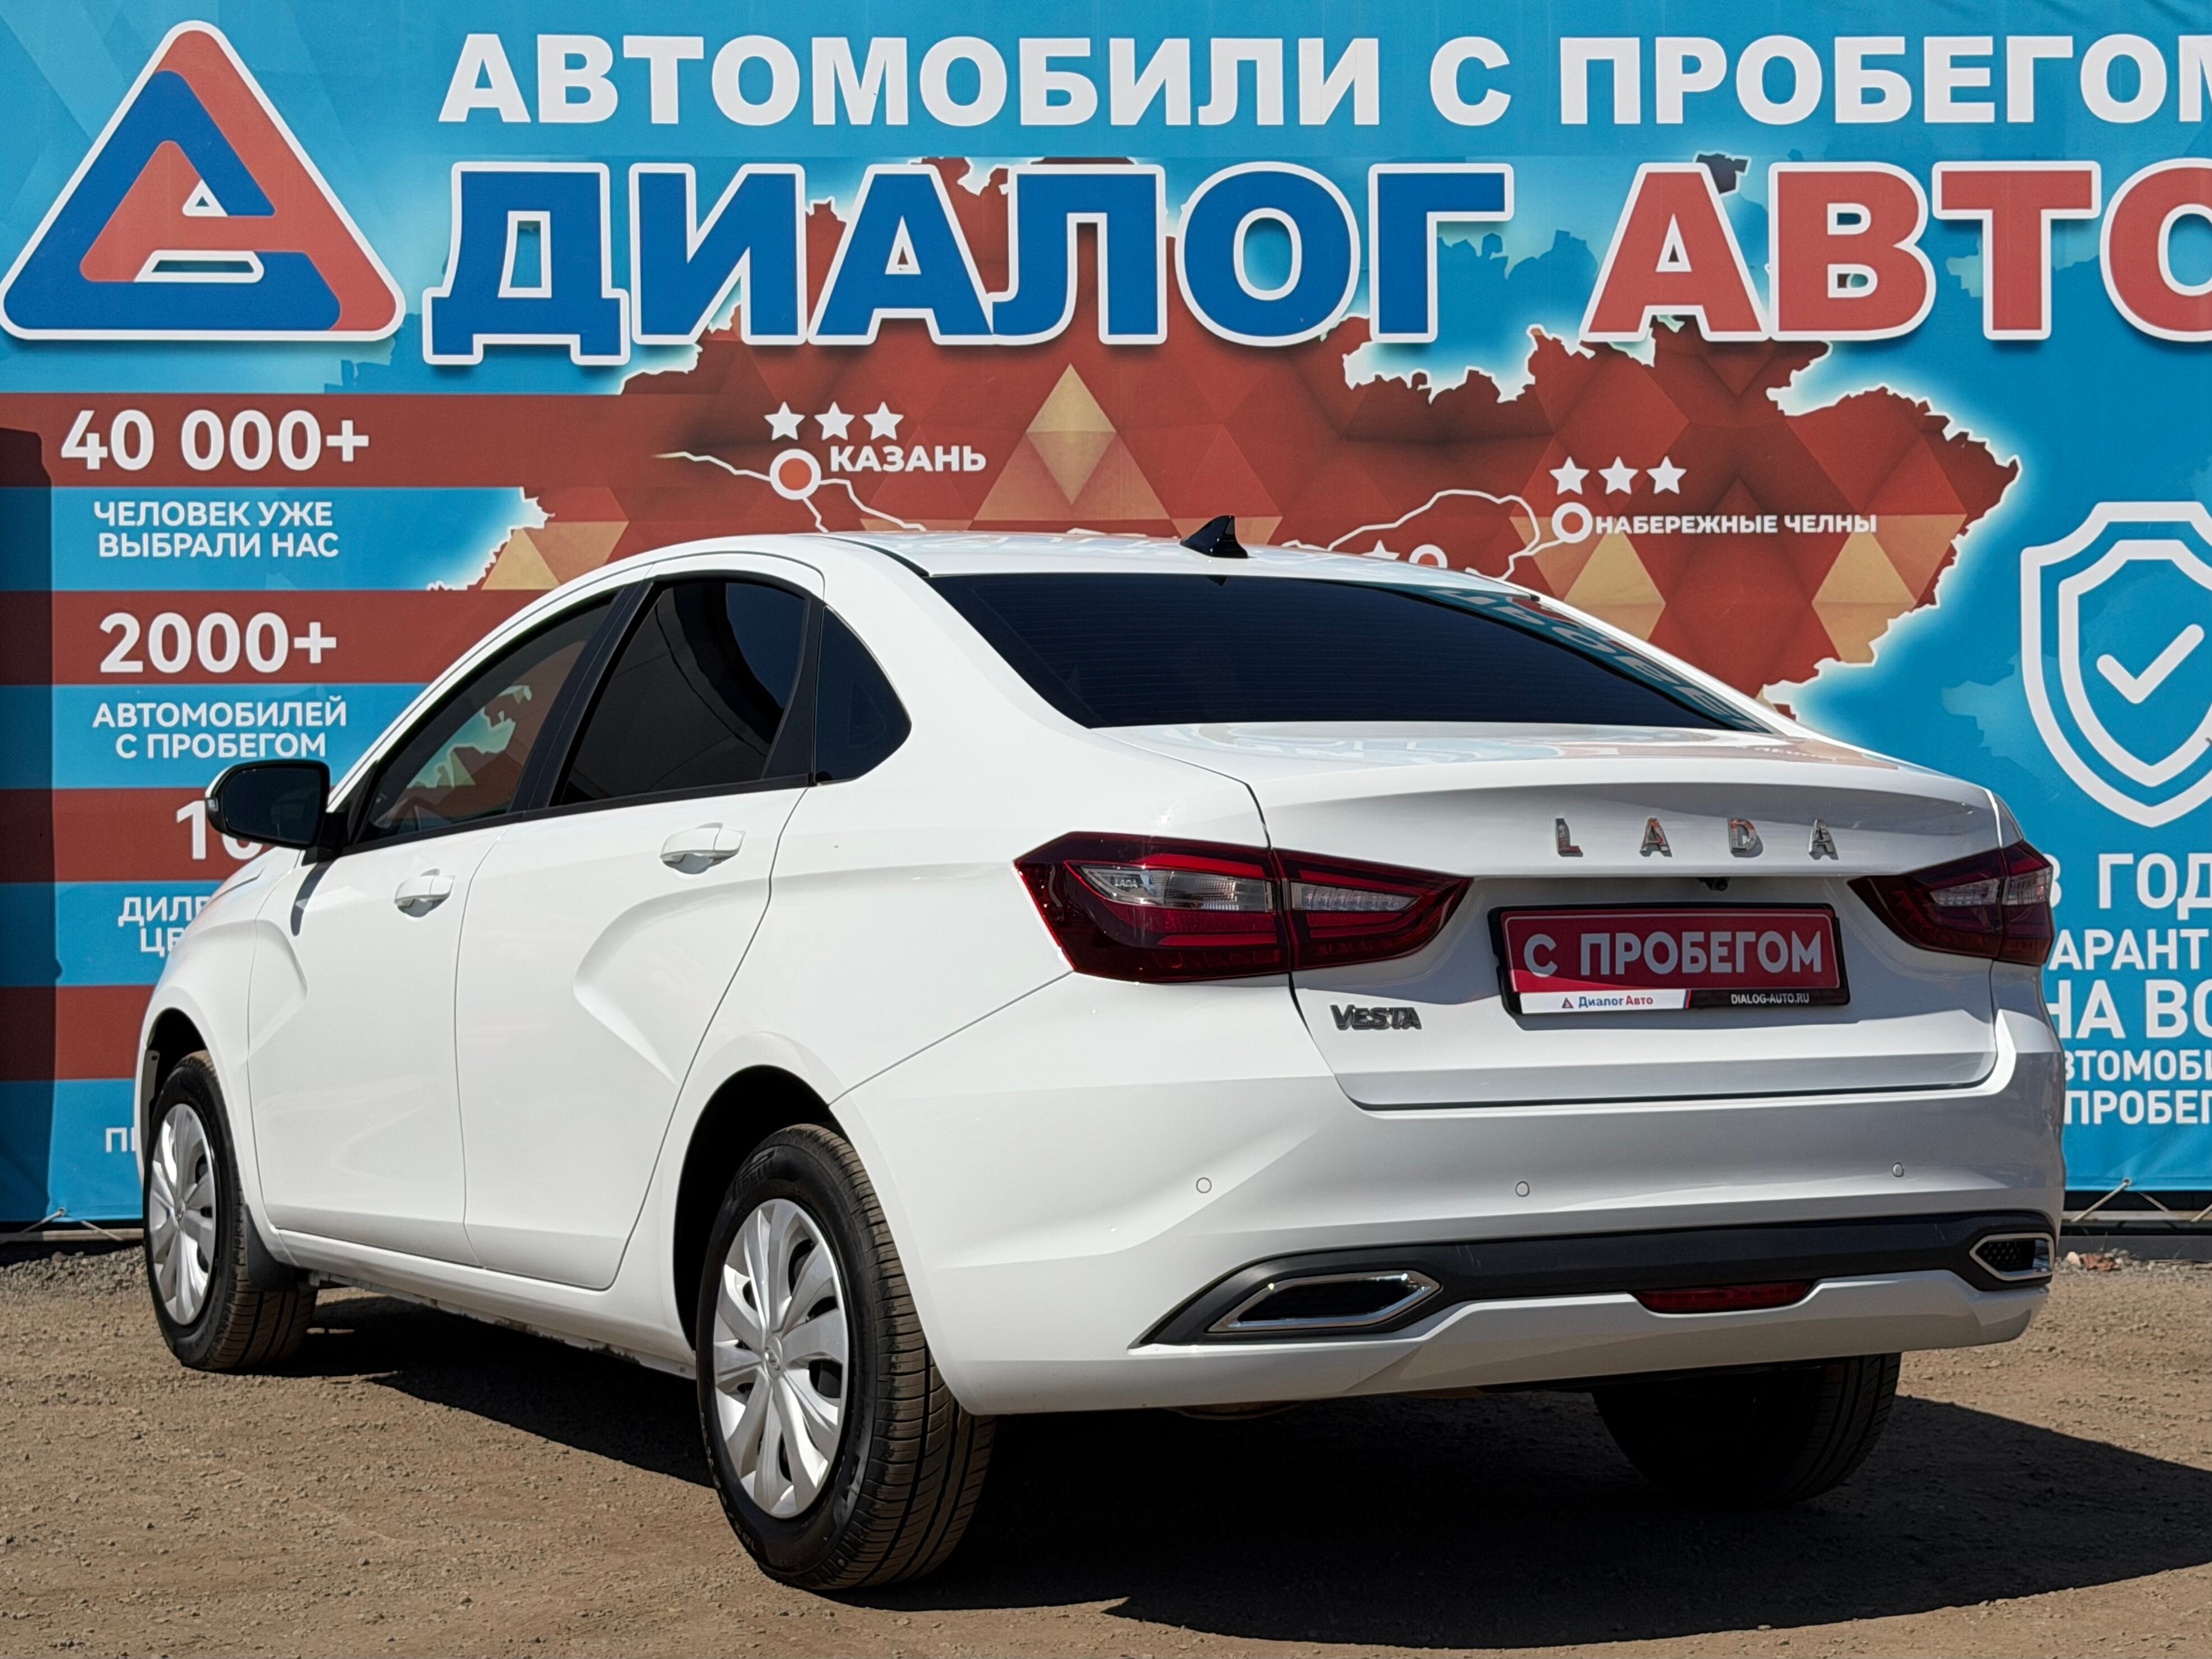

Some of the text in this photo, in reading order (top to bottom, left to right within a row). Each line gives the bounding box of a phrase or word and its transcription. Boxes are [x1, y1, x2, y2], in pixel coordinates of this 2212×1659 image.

[439, 34, 1379, 126] АВТОМОБИЛИ
[1430, 37, 1511, 126] С
[422, 158, 2212, 365] ДИАЛОГ АВТО
[61, 410, 369, 471] 40 000+
[830, 446, 986, 472] КАЗАНЬ
[94, 501, 333, 526] ЧЕЛОВЕК УЖЕ
[1596, 514, 1877, 534] НАБЕРЕЖНЫЕ ЧЕЛНЫ
[99, 533, 339, 557] ВЫБРАЛИ НАС
[100, 612, 336, 673] 2000+
[93, 696, 347, 728] АВТОМОБИЛЕЙ
[116, 733, 326, 758] С ПРОБЕГОМ
[1555, 816, 1840, 860] LADA
[1523, 930, 1822, 978] С ПРОБЕГОМ
[1578, 995, 1654, 1008] Диалог Авто
[1731, 993, 1810, 1005] DIALOG-AUTO.RU
